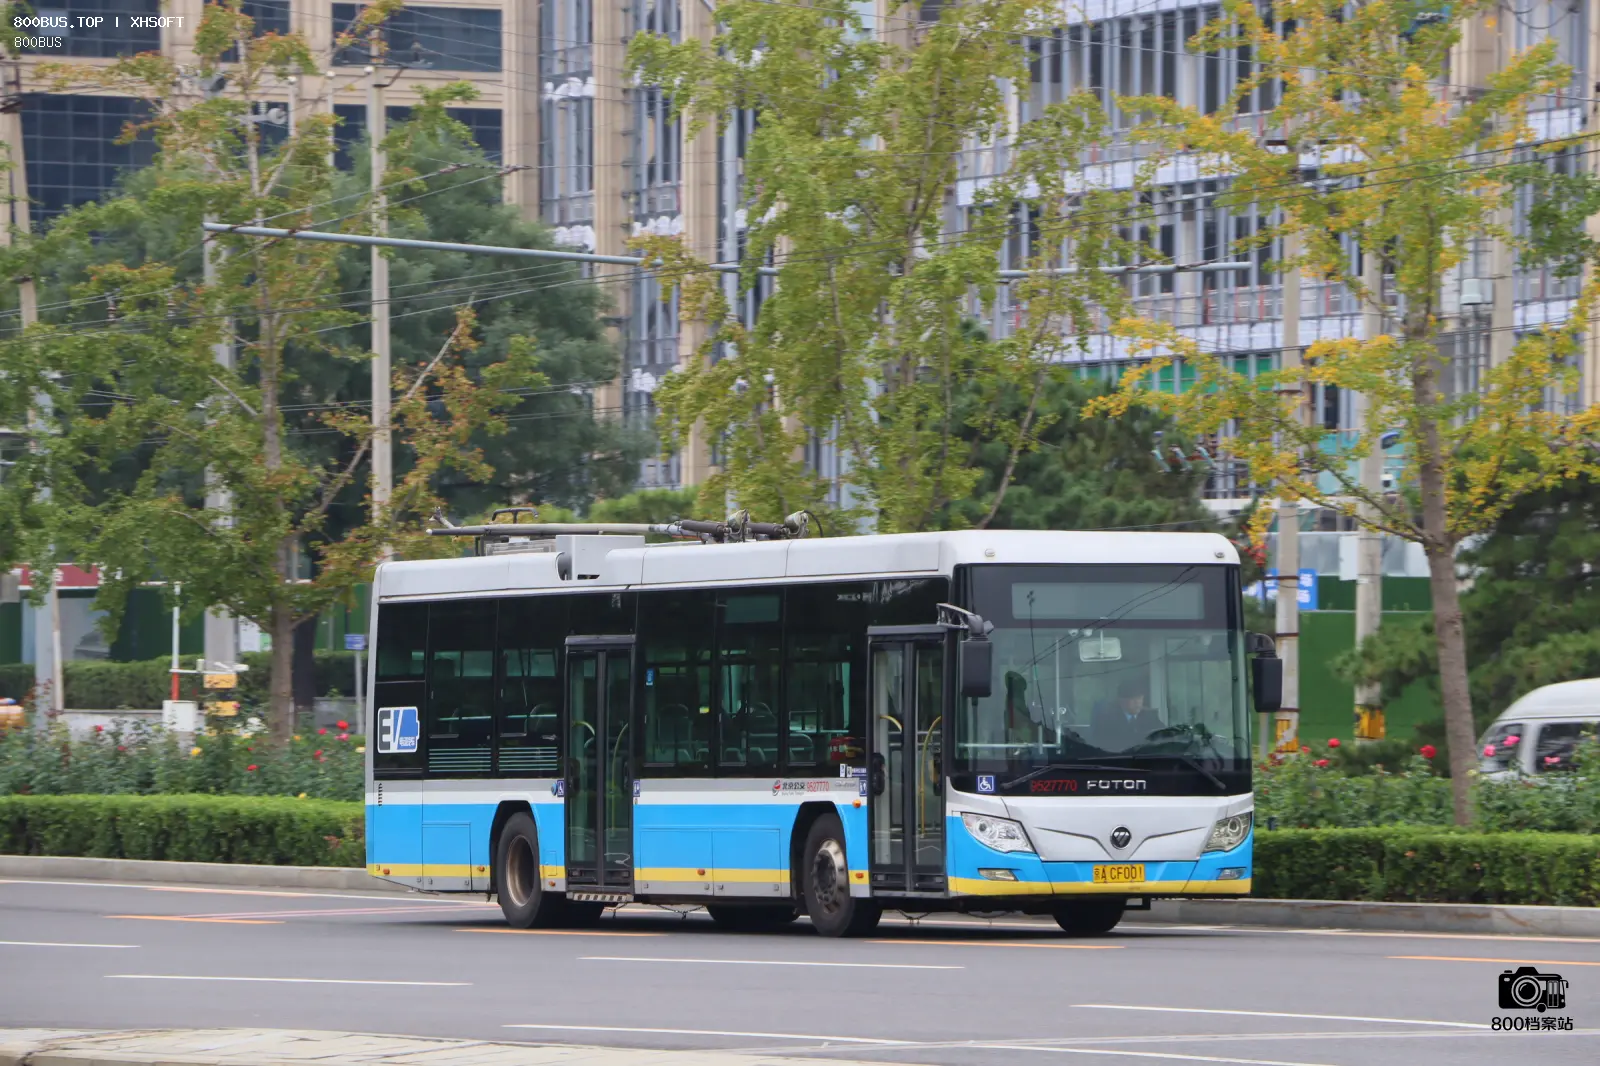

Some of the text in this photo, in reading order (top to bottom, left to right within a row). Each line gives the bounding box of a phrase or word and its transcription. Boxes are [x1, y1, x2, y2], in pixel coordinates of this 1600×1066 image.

[807, 781, 830, 792] 9527770
[1031, 779, 1078, 792] 9527770
[1086, 779, 1147, 790] FOTON
